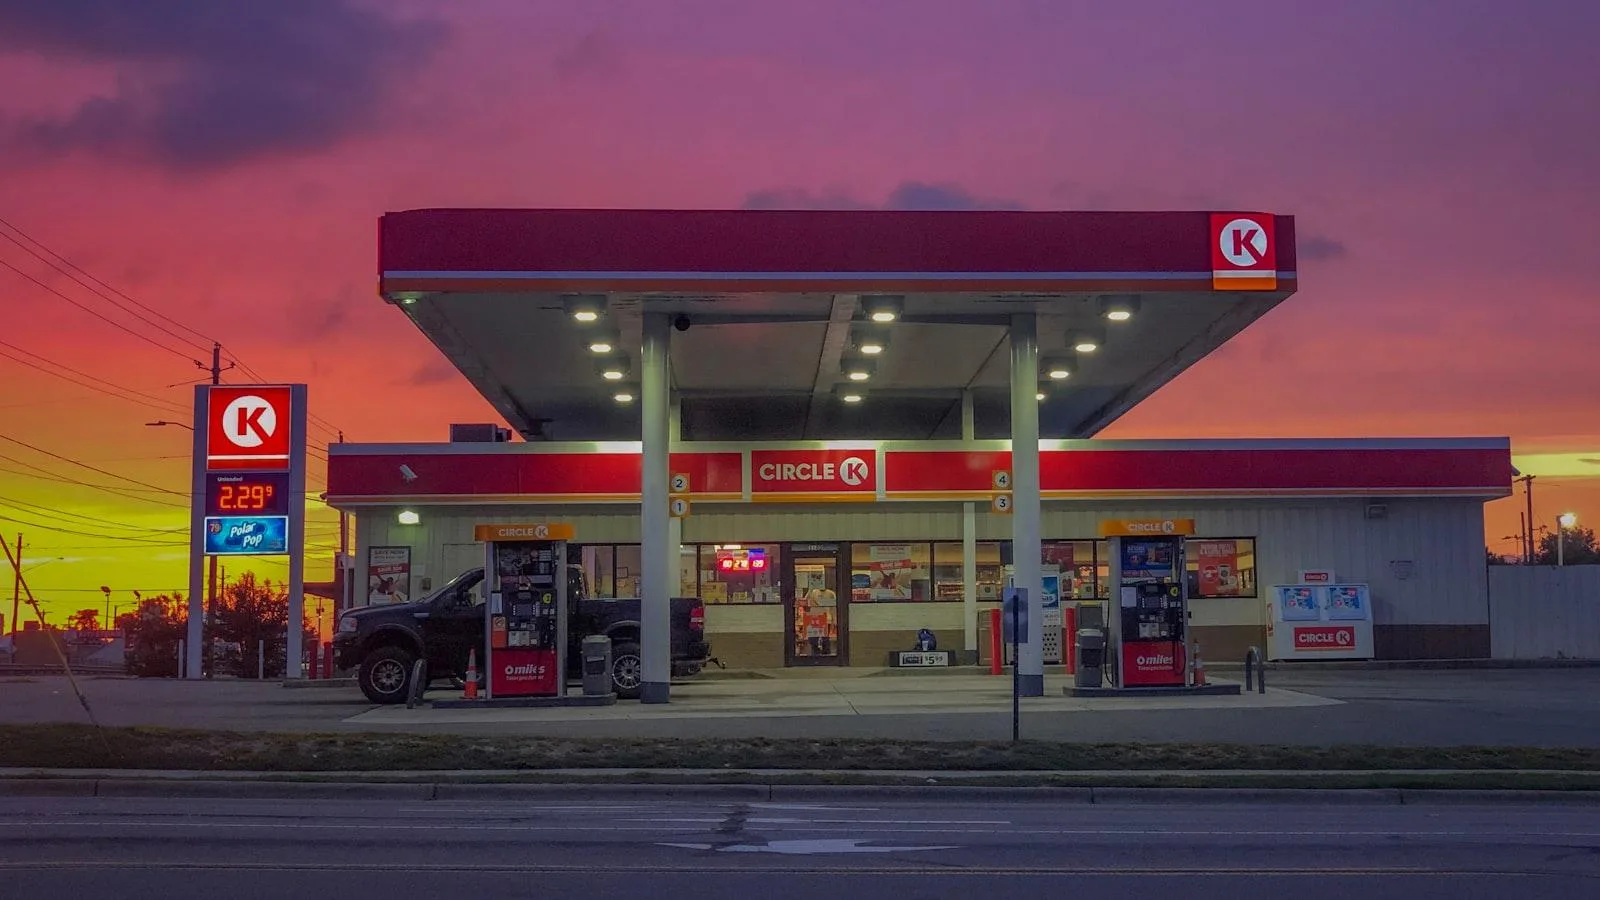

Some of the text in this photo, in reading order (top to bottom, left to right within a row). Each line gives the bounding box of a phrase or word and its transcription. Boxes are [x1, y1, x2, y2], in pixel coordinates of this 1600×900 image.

[1231, 228, 1265, 264] K
[235, 405, 273, 445] K
[759, 462, 866, 485] CIRCLE K
[675, 479, 683, 488] 2
[999, 475, 1006, 484] 4
[999, 498, 1006, 508] 3
[230, 522, 257, 538] Polar
[498, 528, 534, 537] CIRCLE
[1128, 523, 1162, 531] CIRCLE
[242, 534, 263, 548] Pop
[1298, 632, 1334, 643] CIRCLE
